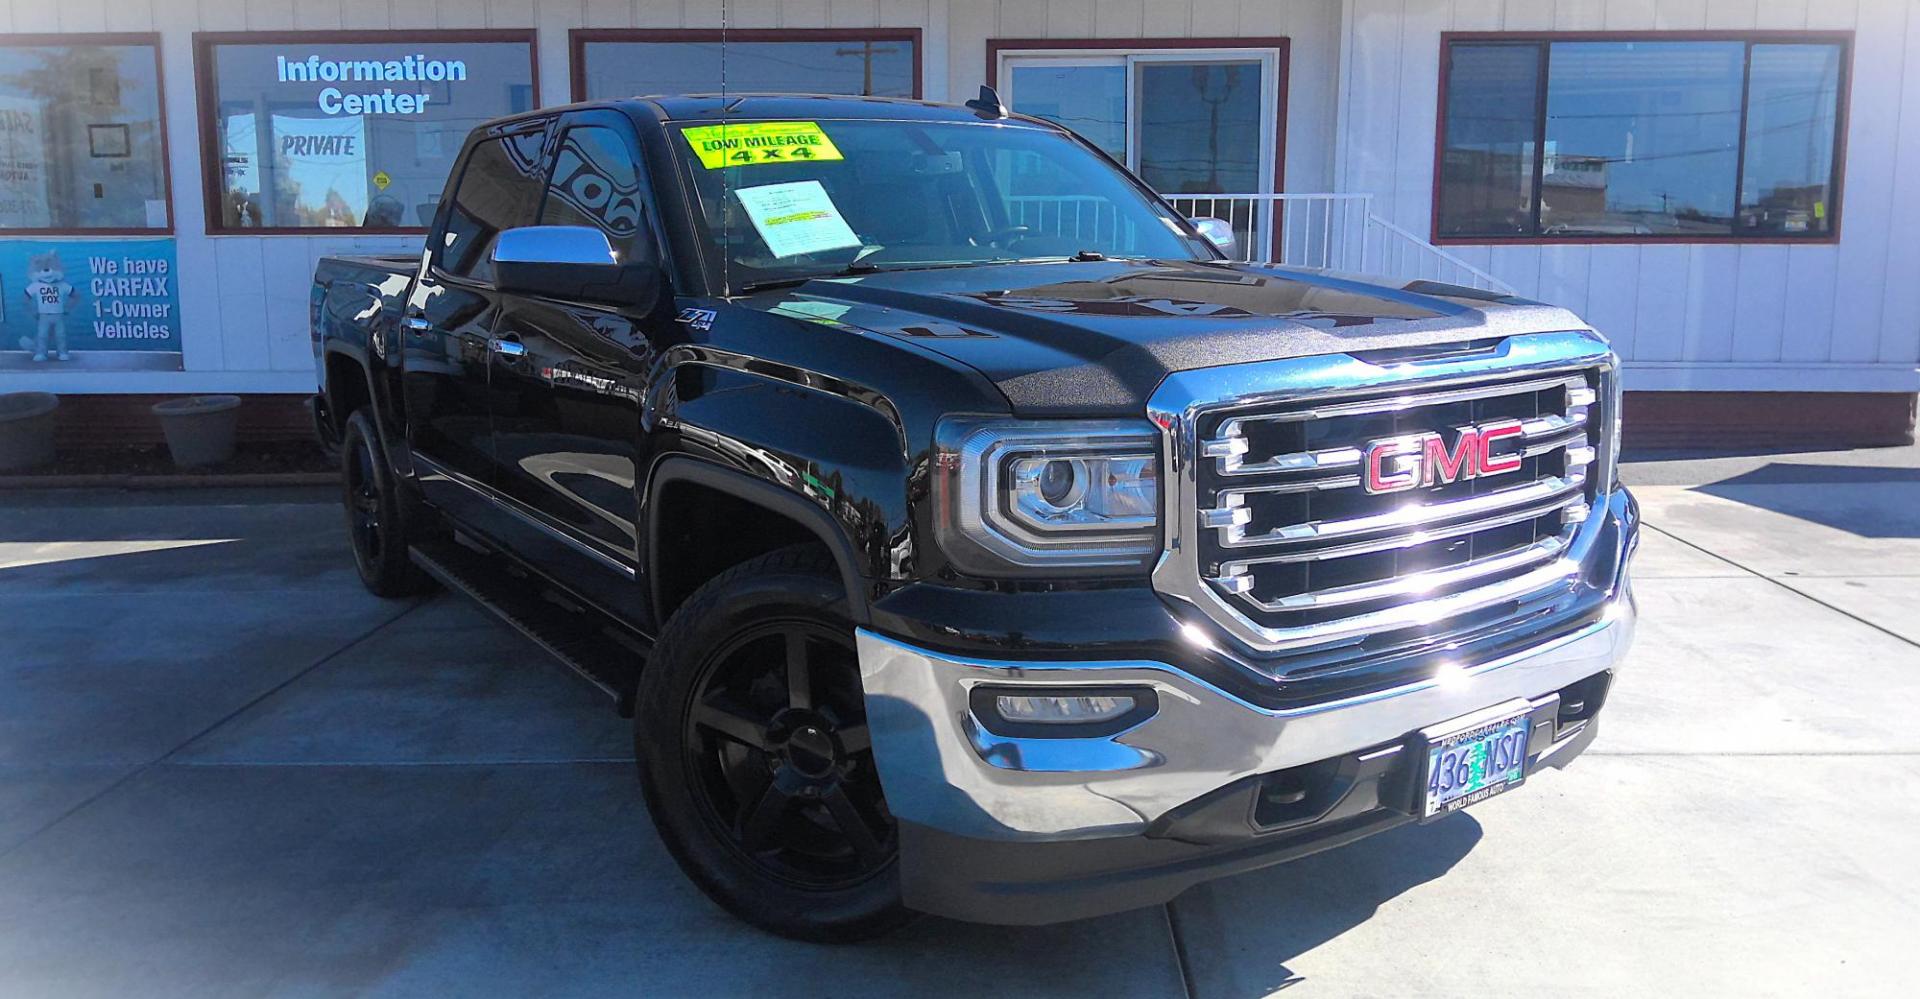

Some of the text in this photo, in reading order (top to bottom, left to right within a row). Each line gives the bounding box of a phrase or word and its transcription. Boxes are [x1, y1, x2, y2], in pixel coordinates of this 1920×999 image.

[277, 54, 467, 82] Information
[318, 87, 430, 115] Center
[281, 135, 357, 157] PRIVATE
[702, 134, 822, 152] LOW MILEAGE
[731, 150, 752, 162] 4
[790, 146, 813, 159] 4
[89, 256, 168, 275] We have
[40, 287, 60, 295] CAR
[91, 278, 169, 297] CARFAX
[41, 296, 60, 305] FOX
[93, 300, 171, 318] 1-Owner
[93, 321, 170, 339] Vehicles
[1365, 418, 1523, 495] GMC
[1429, 748, 1469, 797] 436
[1447, 795, 1468, 813] WORLD
[1467, 787, 1489, 805] FAMOUS
